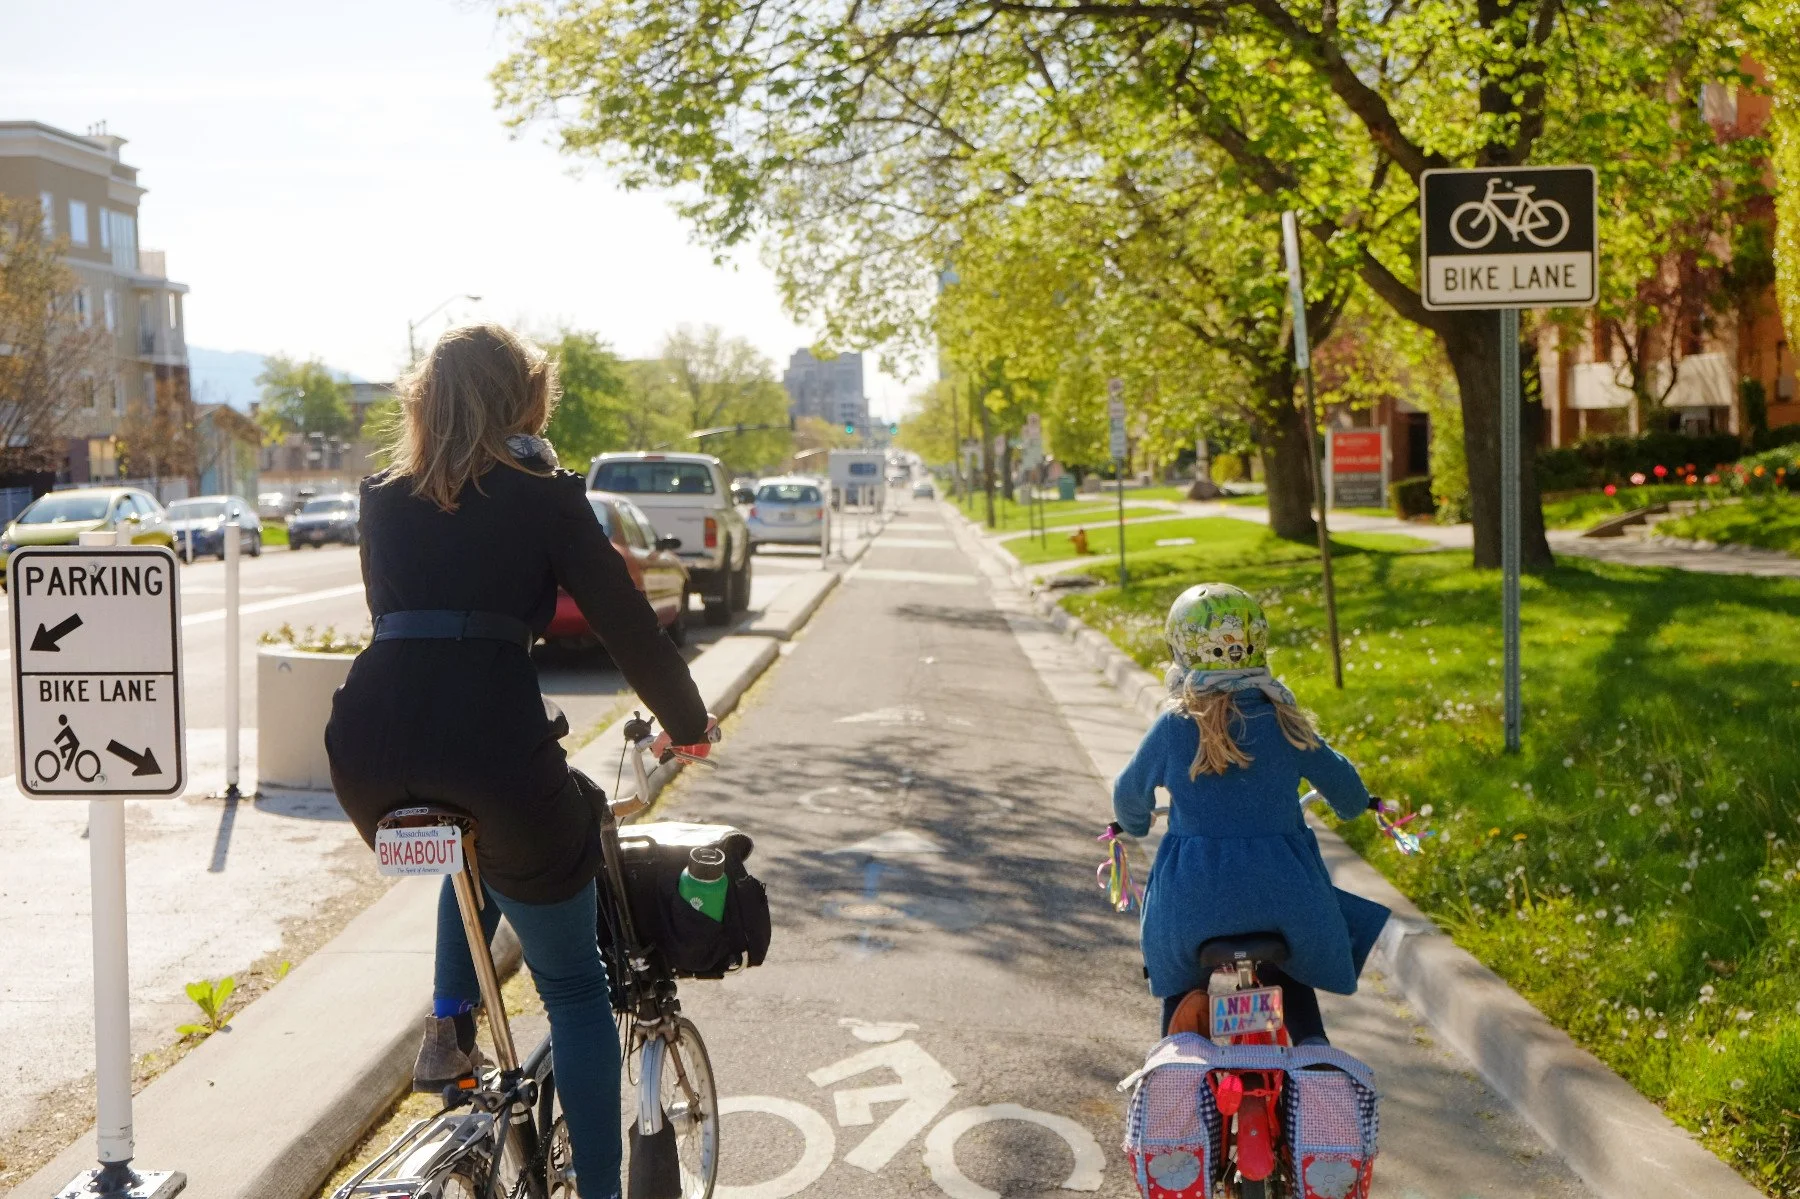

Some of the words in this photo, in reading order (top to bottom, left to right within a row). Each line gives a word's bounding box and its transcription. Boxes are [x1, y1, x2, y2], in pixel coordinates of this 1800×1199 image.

[1444, 267, 1500, 292] BIKE
[1513, 264, 1577, 290] LANE
[26, 566, 163, 596] PARKING
[39, 680, 90, 702] BIKE
[100, 680, 157, 702] LANE
[395, 829, 439, 839] Massachusetts
[379, 840, 457, 866] BIKABOUT
